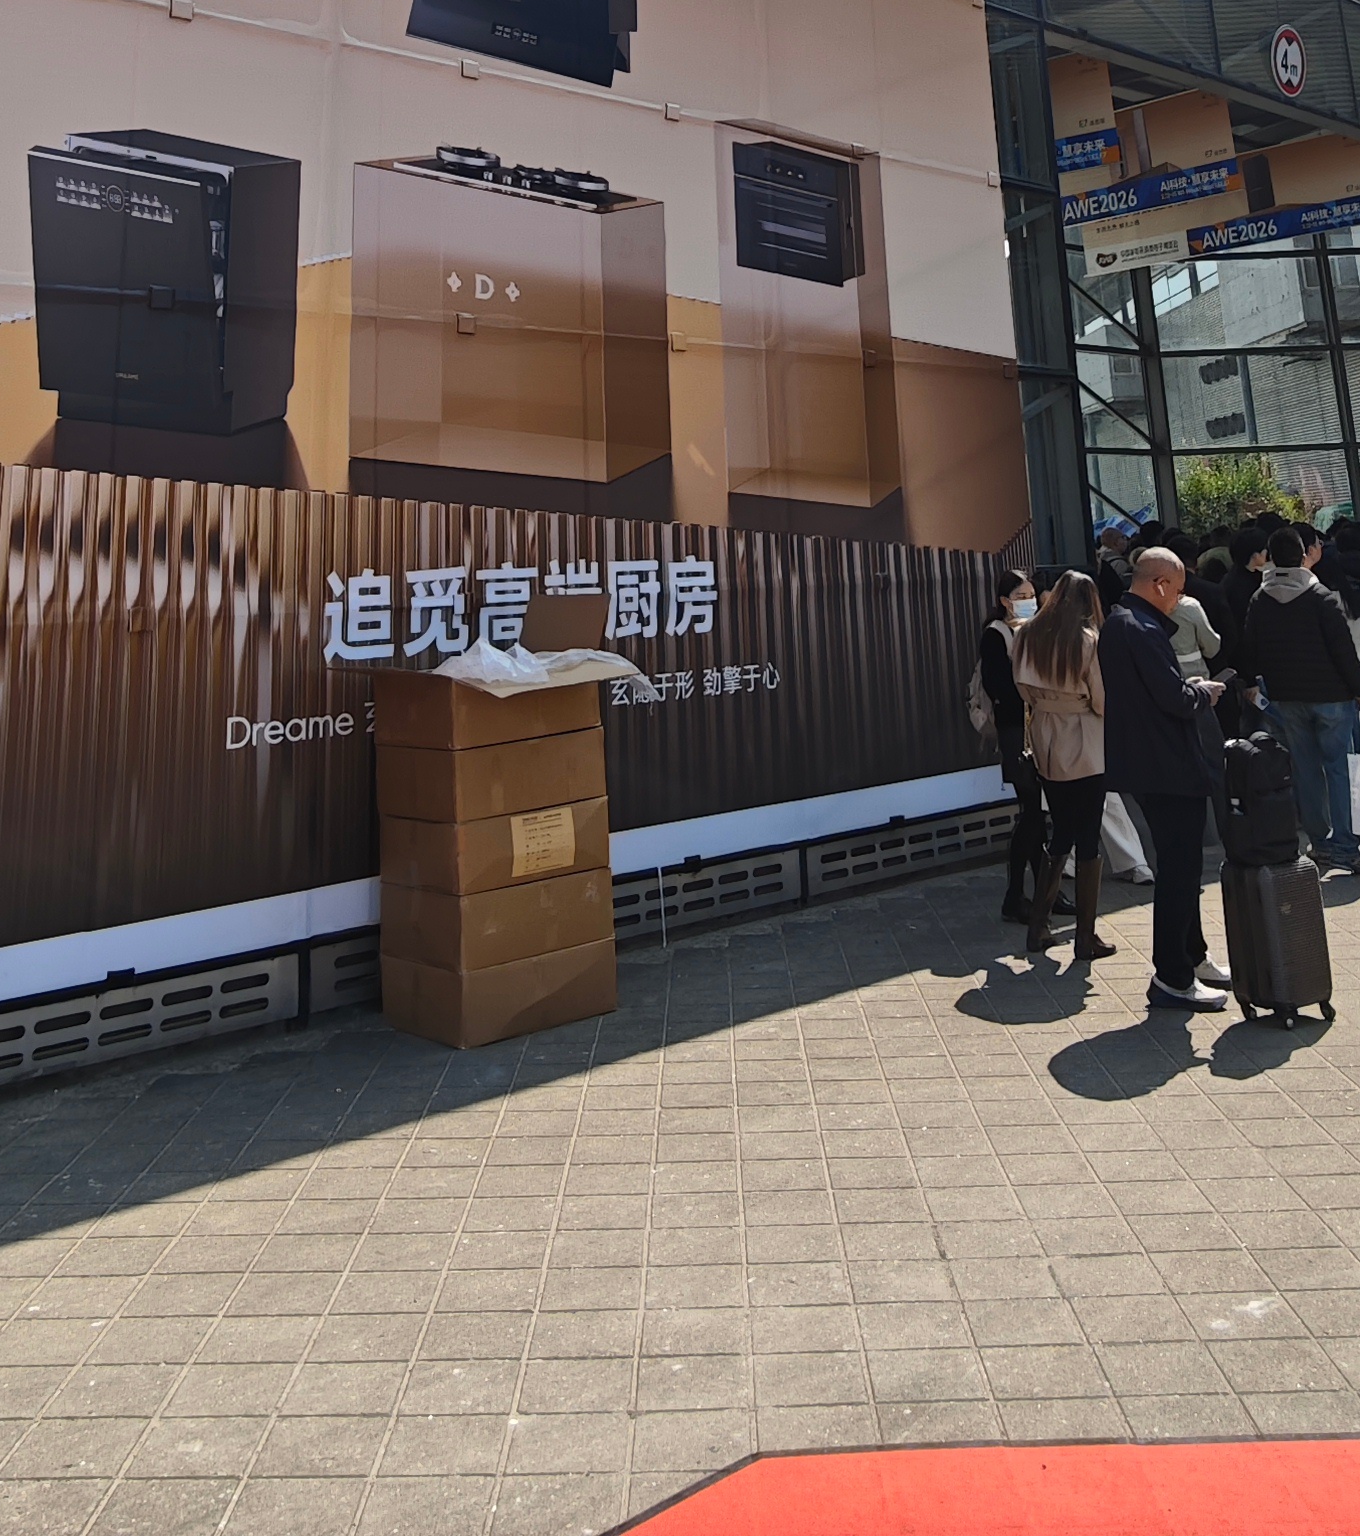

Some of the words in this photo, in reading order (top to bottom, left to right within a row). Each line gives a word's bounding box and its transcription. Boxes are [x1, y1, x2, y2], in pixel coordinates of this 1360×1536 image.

[1063, 188, 1138, 221] AWE2026
[1202, 219, 1278, 250] AWE2026
[474, 272, 495, 300] D
[702, 661, 781, 697] 劲擎于心
[225, 710, 355, 750] Dreame
